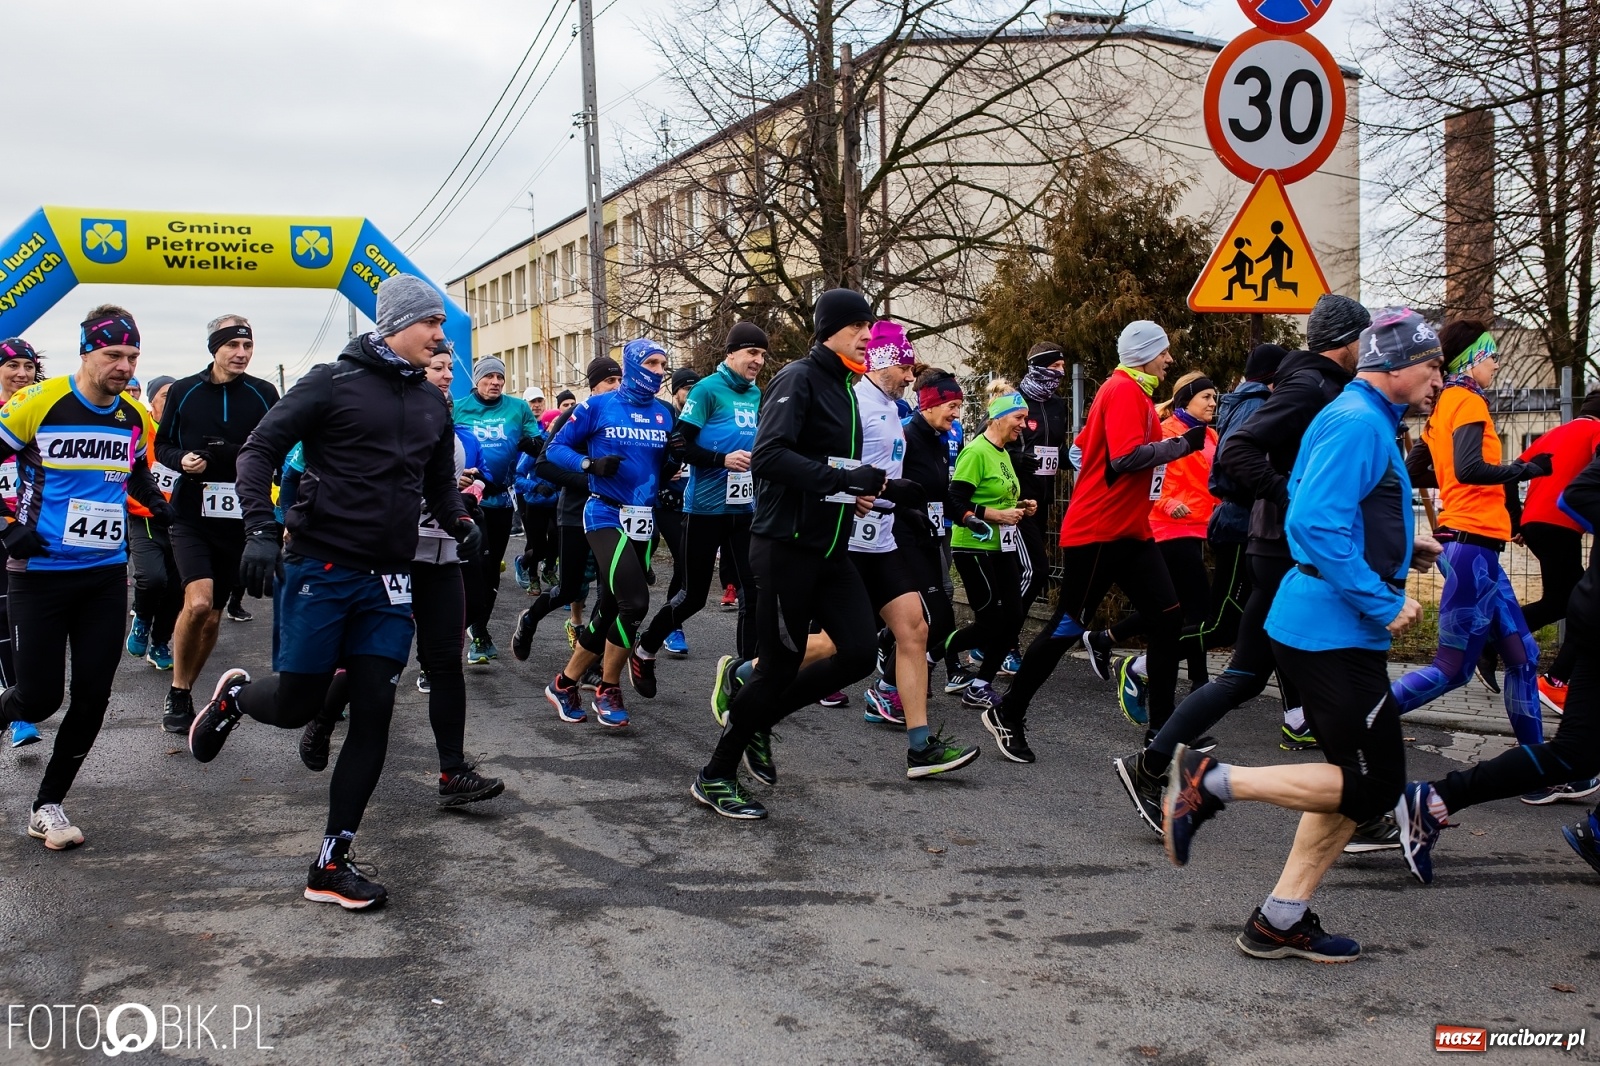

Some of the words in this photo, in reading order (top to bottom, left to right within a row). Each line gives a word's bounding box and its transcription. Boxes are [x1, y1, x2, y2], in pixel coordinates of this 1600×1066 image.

[1228, 65, 1323, 145] 30
[168, 221, 252, 235] Gmina
[2, 231, 47, 272] ludzi
[146, 236, 274, 253] Pietrowice
[163, 254, 258, 271] Wielkie
[365, 244, 401, 278] Gmin
[0, 252, 62, 312] tywnych
[605, 427, 667, 443] RUNNER
[48, 438, 130, 462] CARAMBA
[104, 470, 127, 483] TEAM
[729, 484, 753, 498] 266
[206, 494, 235, 511] 18
[69, 517, 122, 541] 445
[623, 517, 653, 534] 125
